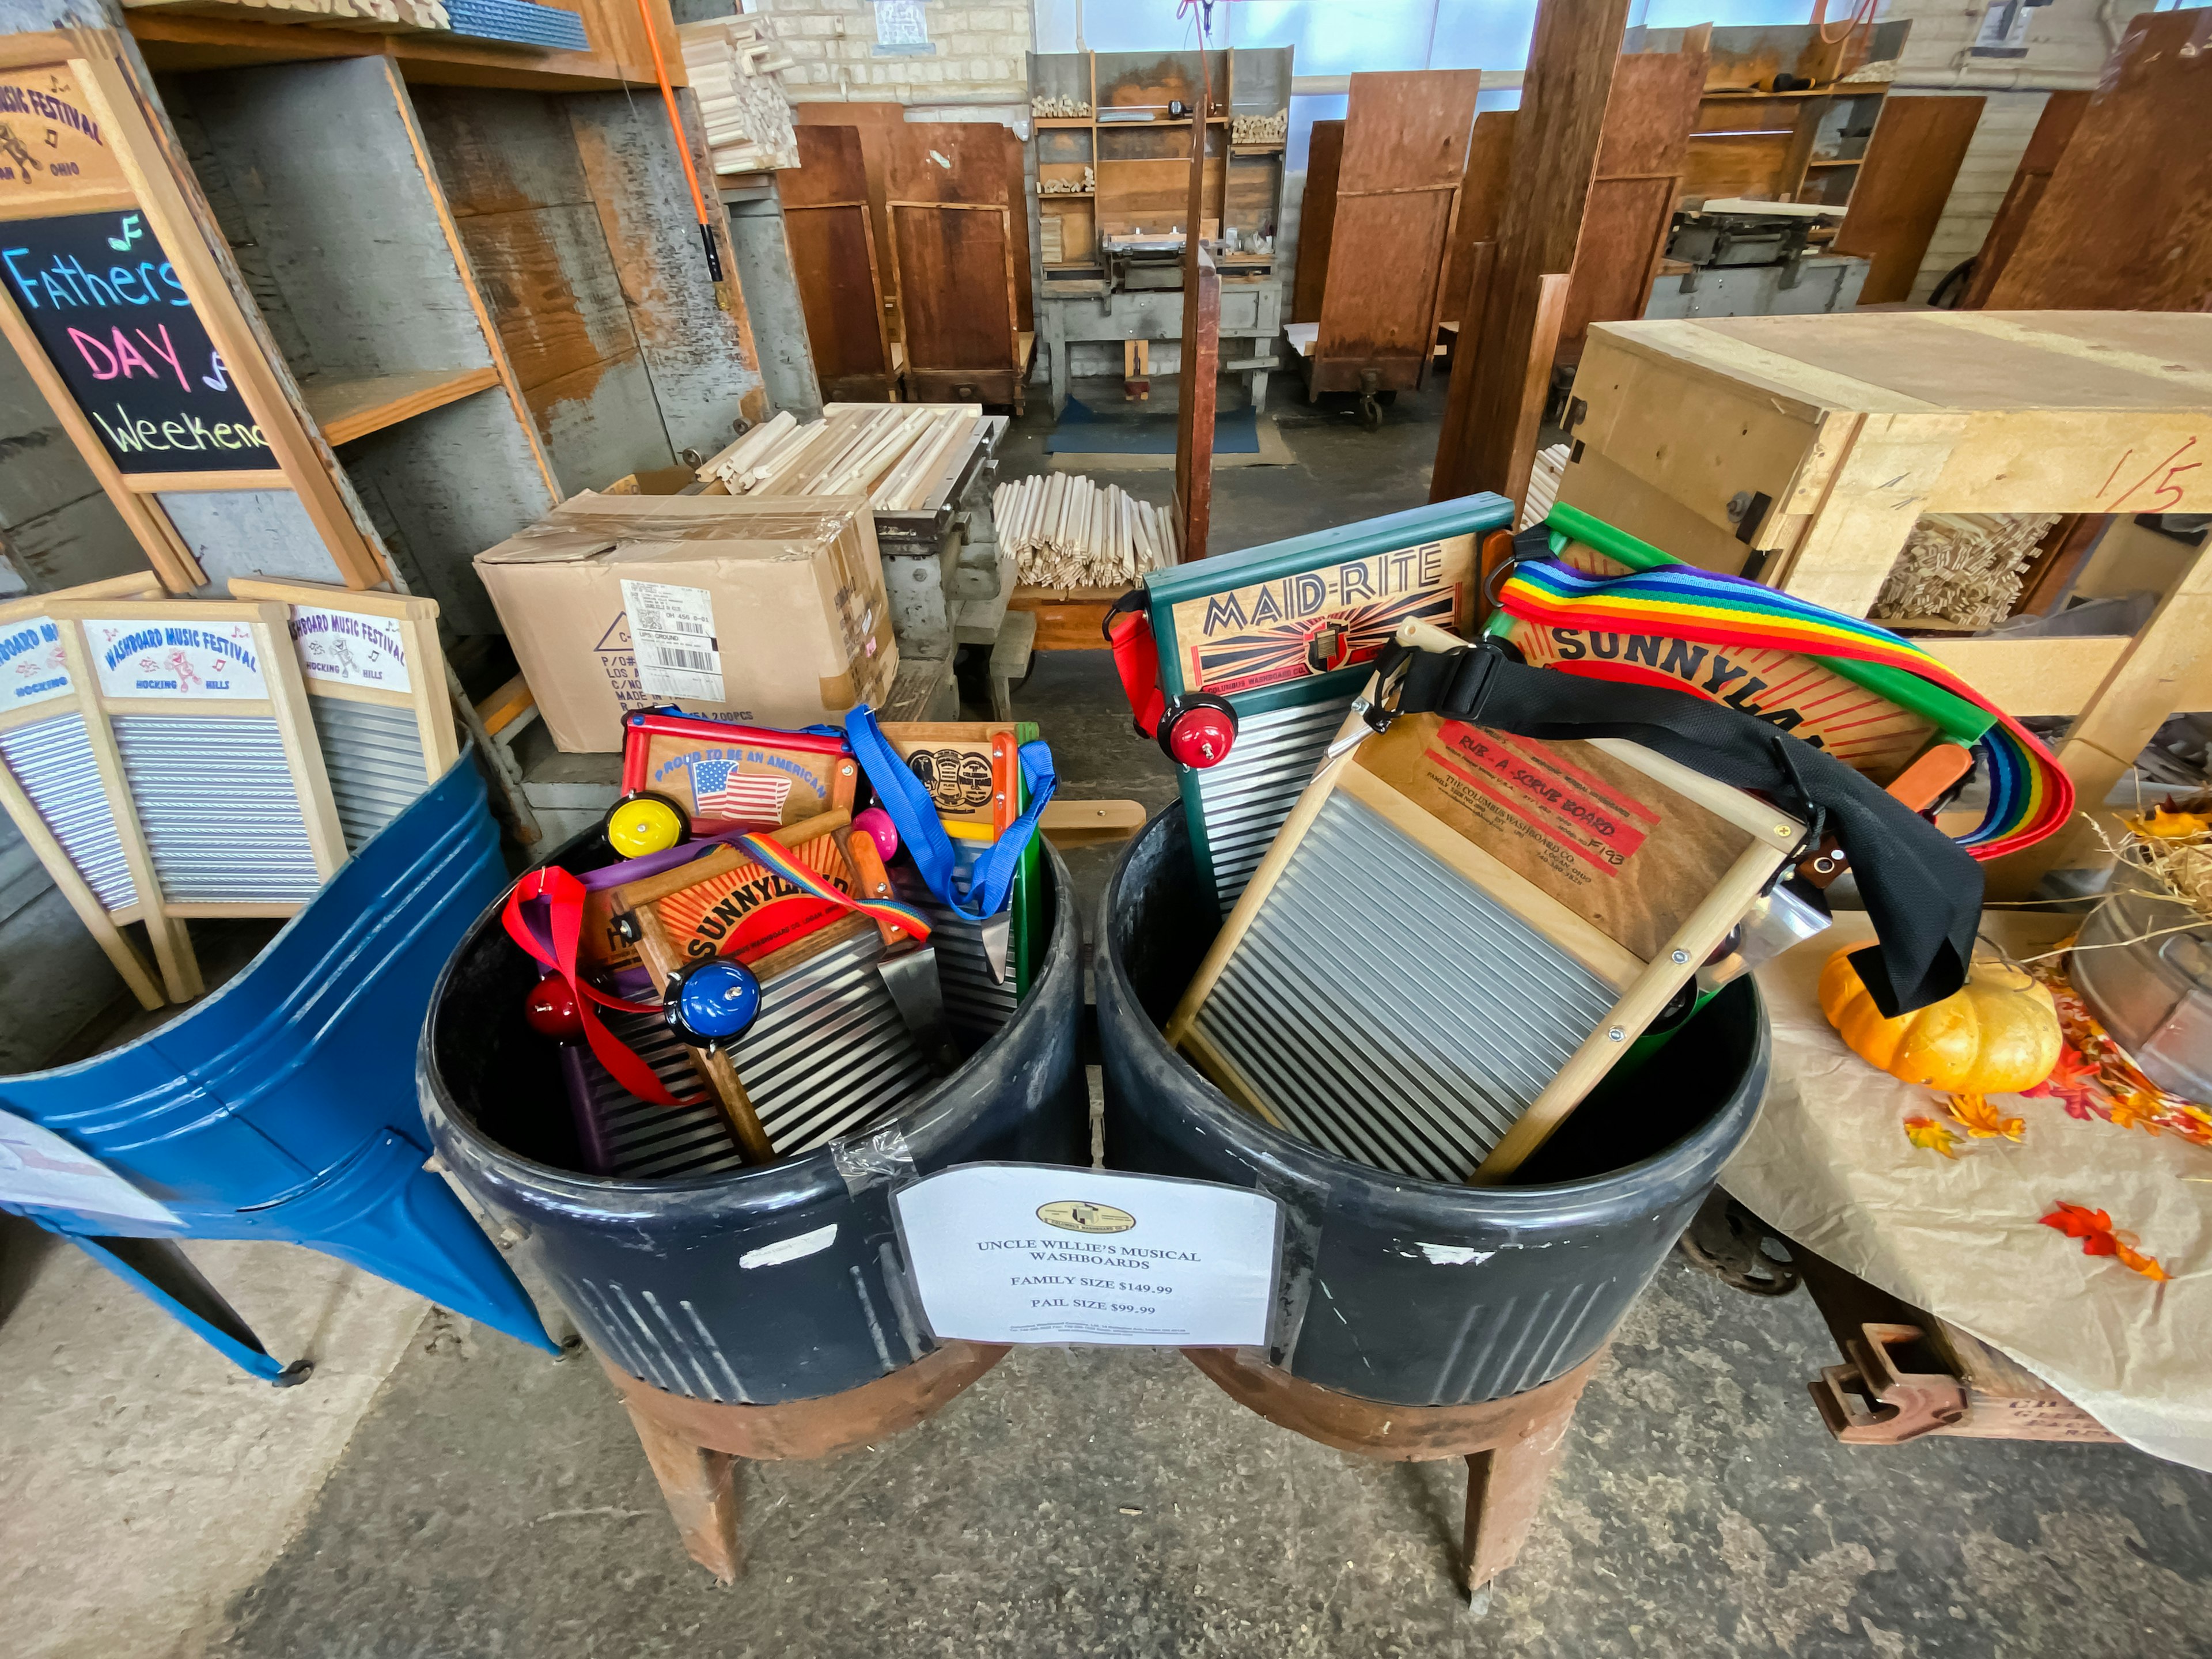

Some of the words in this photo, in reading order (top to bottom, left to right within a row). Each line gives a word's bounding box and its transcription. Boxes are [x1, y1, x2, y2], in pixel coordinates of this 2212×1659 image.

[27, 89, 103, 146] FESTIVAL
[50, 162, 79, 176] OHIO
[67, 324, 192, 393] DAY
[105, 628, 163, 672] WASHBOARD
[165, 628, 200, 647] MUSIC
[202, 632, 256, 673] FESTIVAL
[331, 615, 359, 637] MUSIC
[361, 623, 405, 667] FESTIVAL
[306, 662, 340, 673] HOCKING
[363, 669, 382, 680] HILLS
[606, 669, 628, 678] LOS
[1208, 680, 1245, 694] COLUMBUS
[1248, 670, 1291, 684] WASHBOARD
[136, 680, 177, 689] HOCKING
[206, 681, 229, 690] HILLS
[615, 691, 647, 701] MADE
[655, 751, 702, 782] PROUD
[706, 749, 724, 760] TO
[727, 749, 743, 760] BE
[747, 751, 764, 763] AN
[767, 755, 827, 798] AMERICAN
[1459, 736, 1489, 757] RUB
[1560, 799, 1615, 837] BOARD
[1446, 774, 1464, 790] THE
[1463, 786, 1506, 817] COLUMBUS
[1506, 813, 1560, 853] WASHBOARD
[977, 1240, 1036, 1251] UNCLE
[1040, 1240, 1116, 1255] WILLIE'S
[1120, 1247, 1201, 1262] MUSICAL
[1030, 1252, 1150, 1270] WASHBOARDS
[1011, 1276, 1077, 1286] FAMILY
[1080, 1277, 1115, 1289] SIZE
[1119, 1281, 1173, 1295] $149.99
[1031, 1298, 1069, 1308] PAIL
[1073, 1299, 1107, 1310] SIZE
[1111, 1303, 1156, 1315] $99.99
